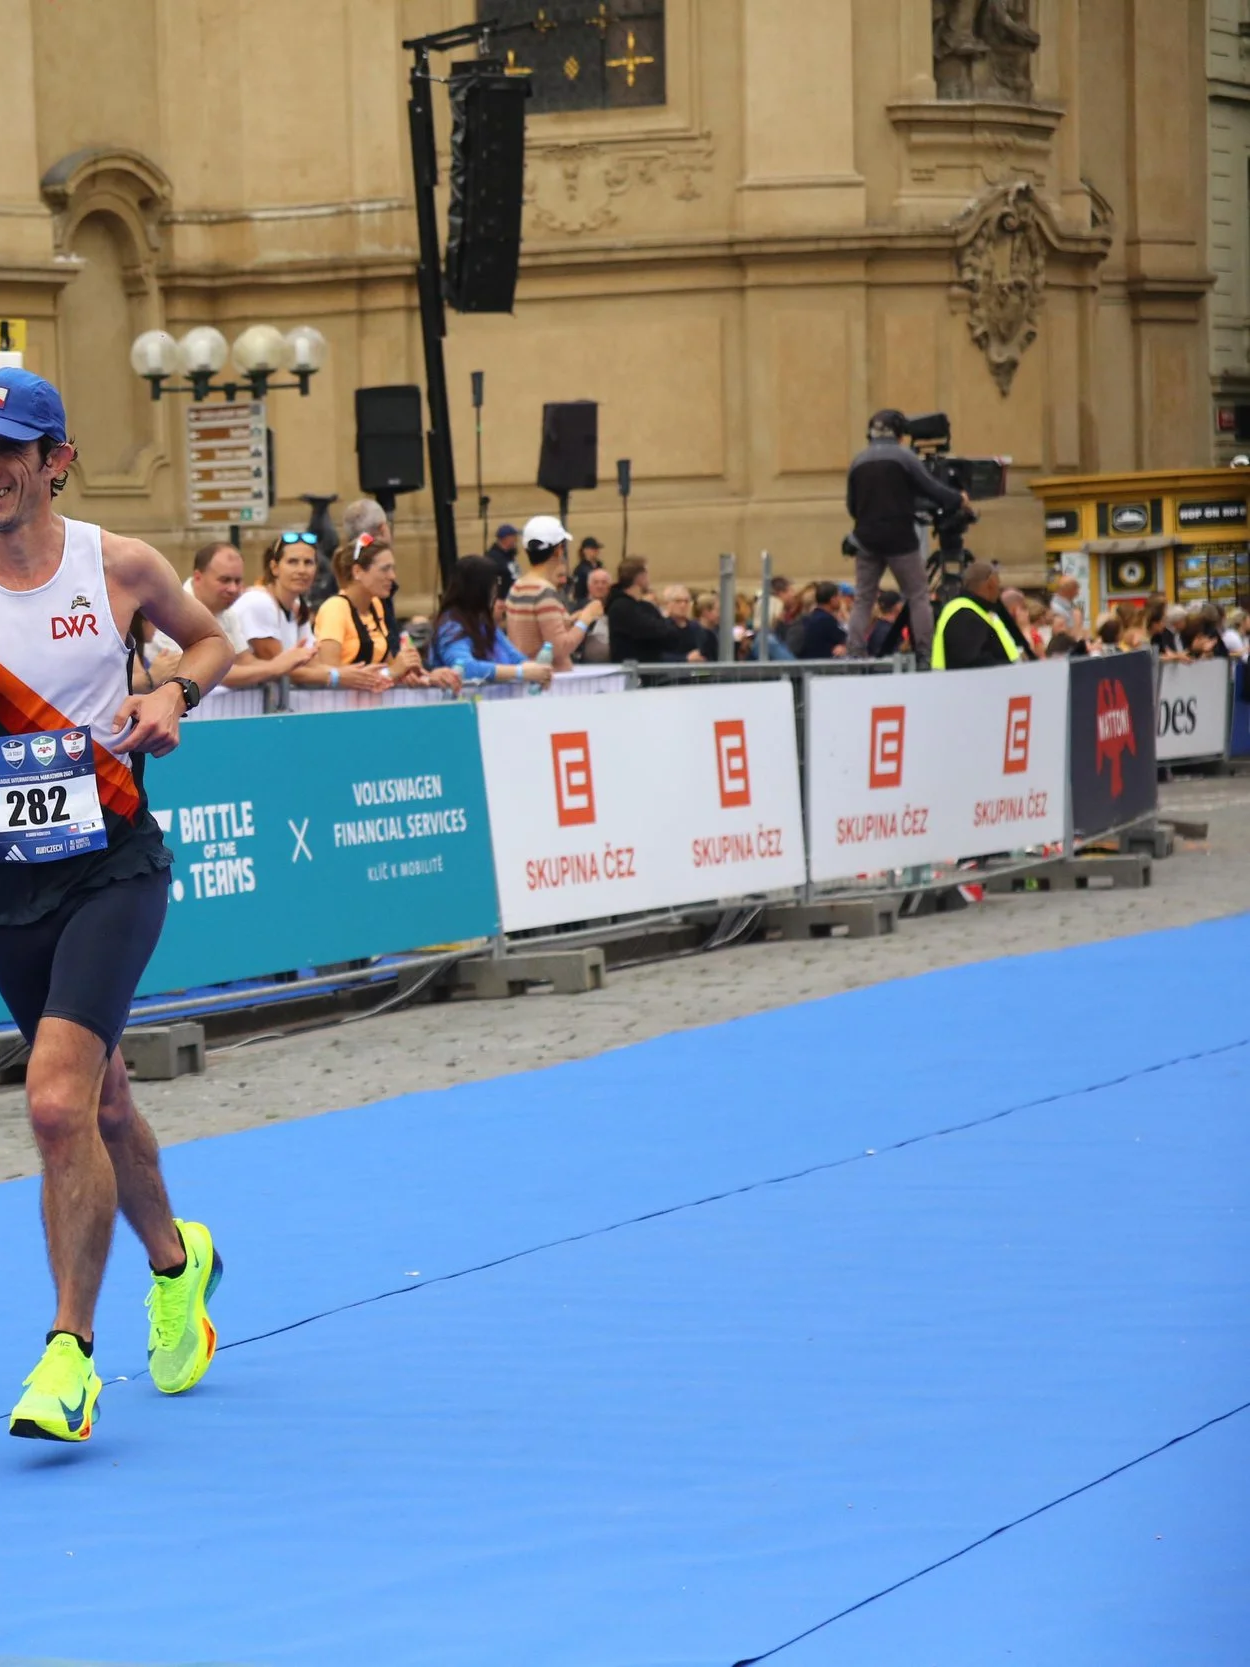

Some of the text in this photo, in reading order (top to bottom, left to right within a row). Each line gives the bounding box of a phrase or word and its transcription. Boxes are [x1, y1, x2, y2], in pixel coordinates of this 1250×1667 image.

[51, 613, 99, 640] DWR
[6, 785, 70, 828] 282
[352, 774, 442, 807] VOLKSWAGEN
[973, 788, 1048, 828] SKUPINA ČEZ
[179, 801, 255, 844] BATTLE
[333, 808, 467, 848] FINANCIAL SERVICES
[836, 803, 929, 846] SKUPINA ČEZ
[203, 841, 237, 859] OF THE
[526, 842, 636, 891] SKUPINA ČEZ
[692, 824, 783, 868] SKUPINA ČEZ
[189, 857, 256, 899] TEAMS
[367, 862, 389, 881] KLÍČ
[391, 864, 398, 878] K
